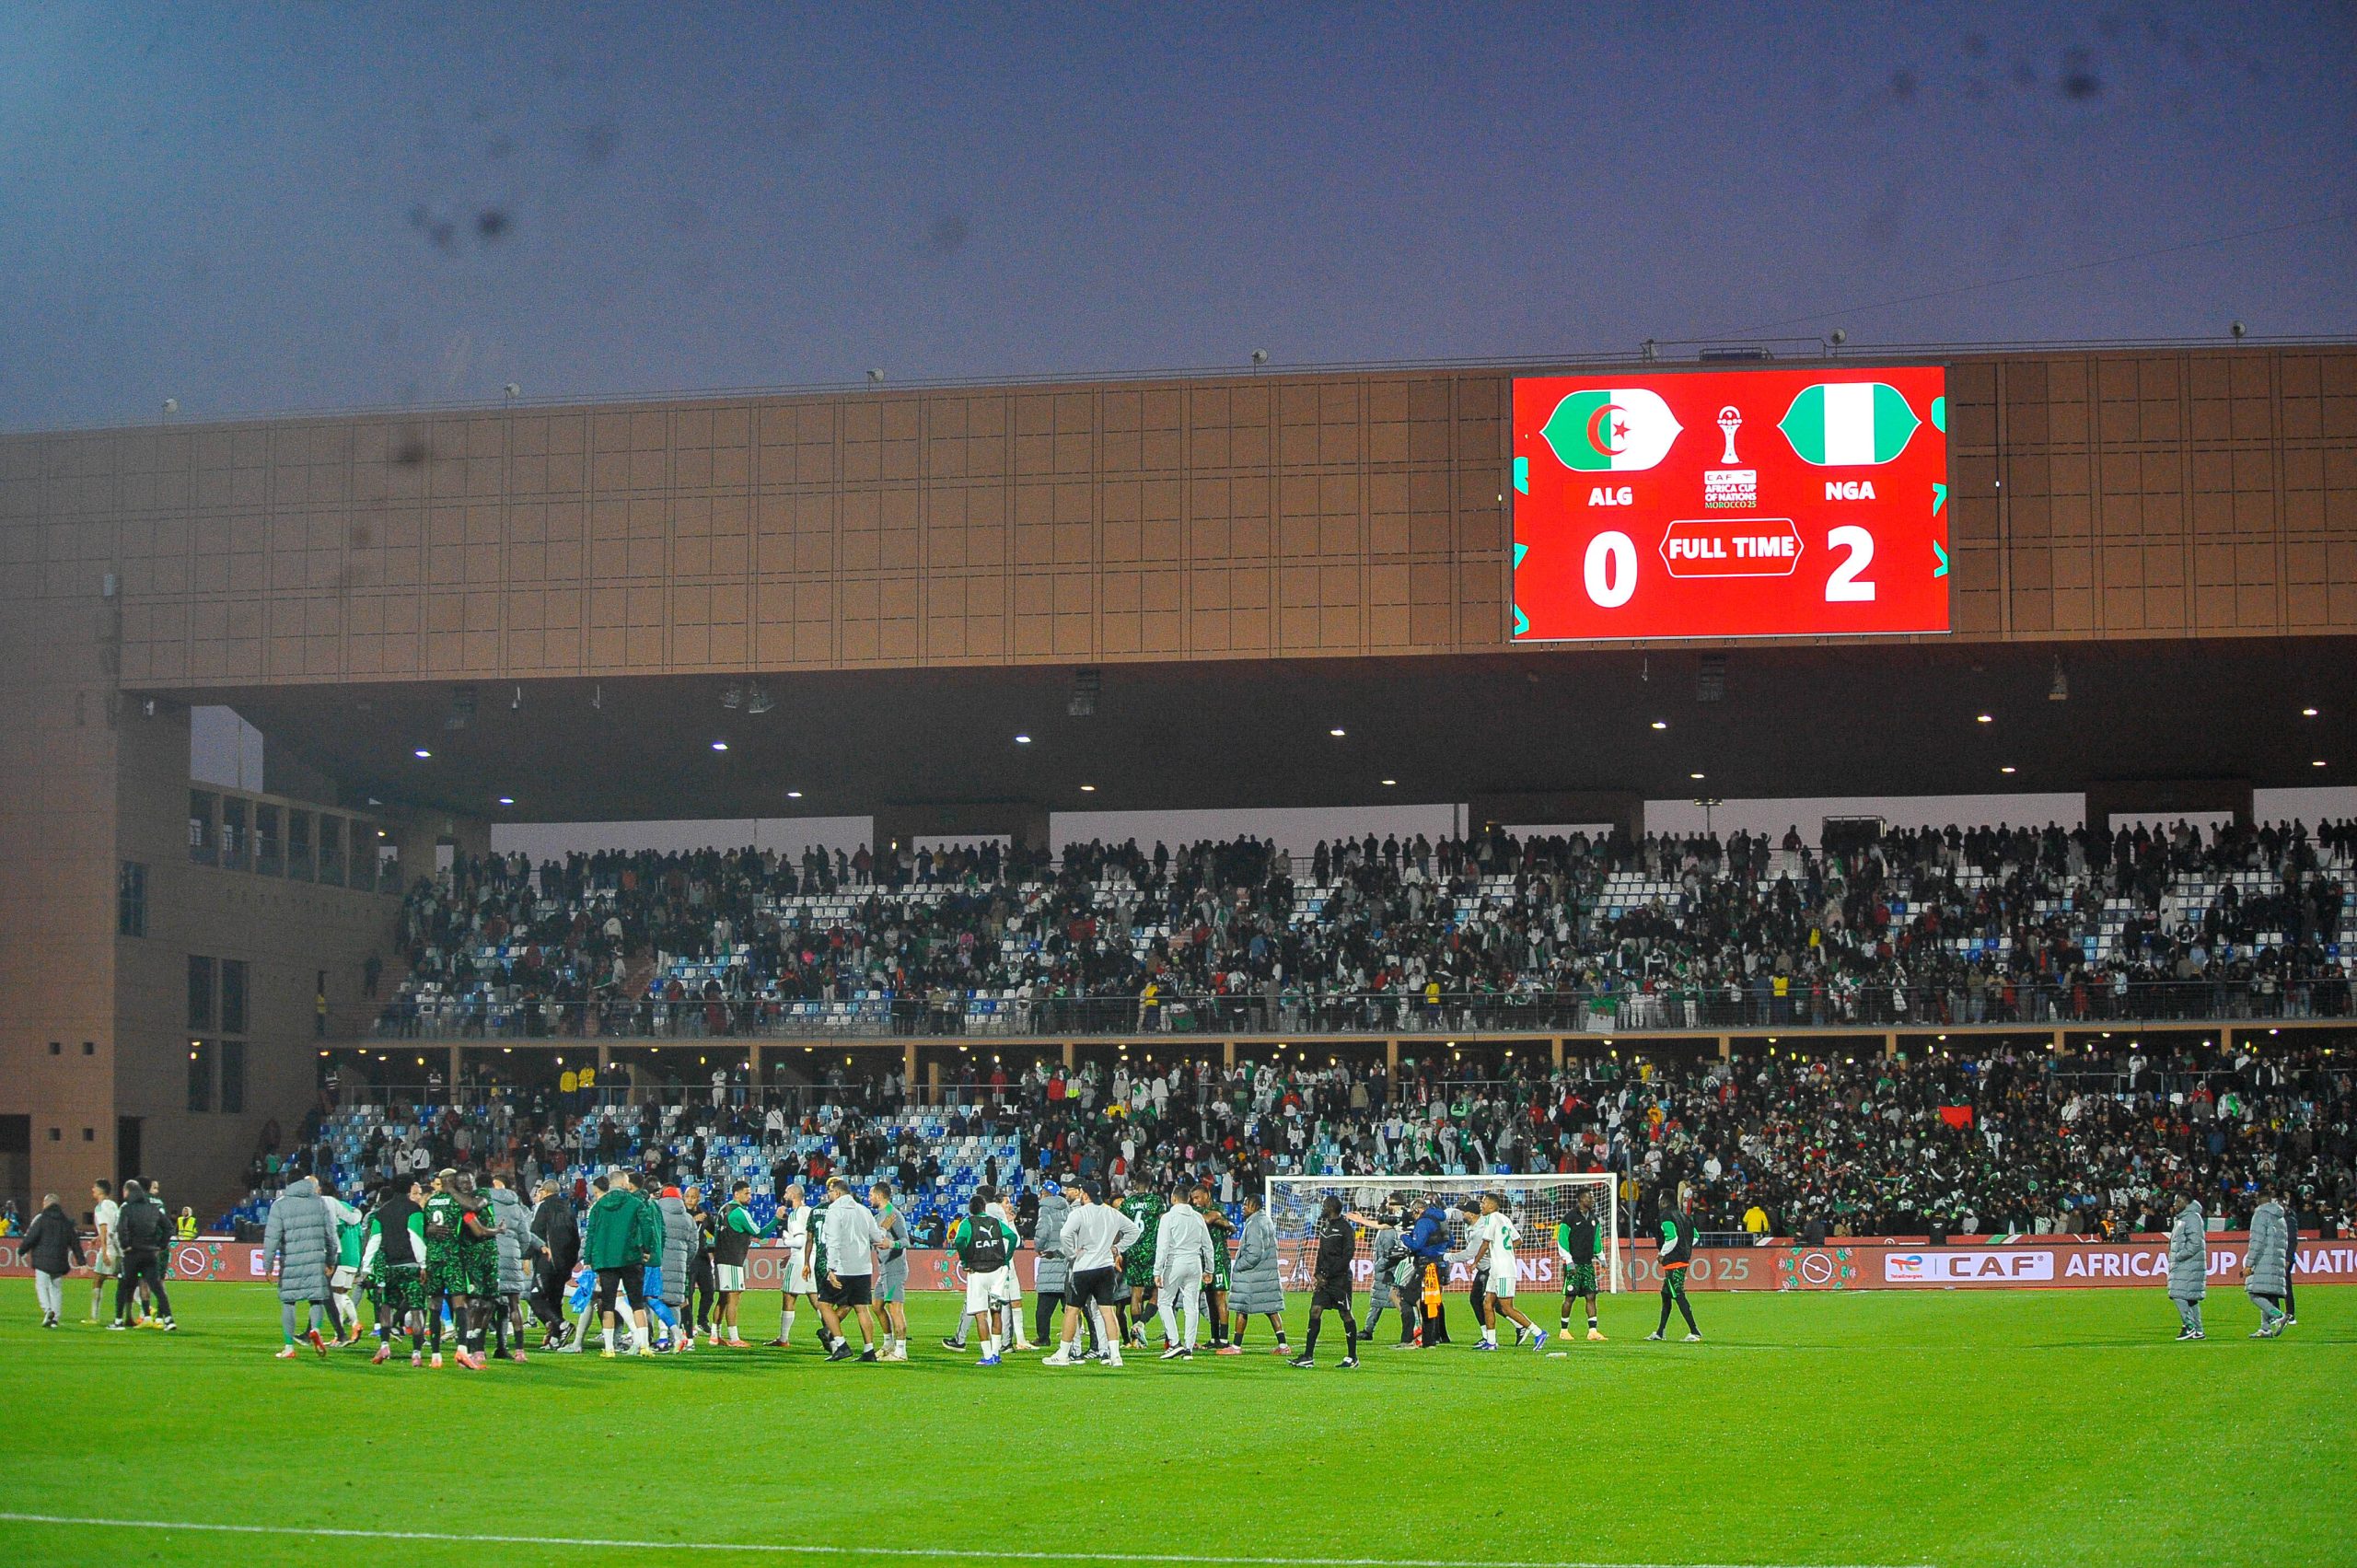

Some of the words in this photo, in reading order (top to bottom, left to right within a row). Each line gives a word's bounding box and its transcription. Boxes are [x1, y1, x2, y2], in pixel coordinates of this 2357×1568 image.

[1588, 487, 1632, 505] ALG
[1705, 484, 1738, 494] AFRICA
[1738, 483, 1757, 493] CUP
[1705, 494, 1718, 502] OF
[1718, 493, 1757, 502] NATIONS
[1826, 481, 1875, 500] NGA
[1669, 538, 1726, 559] FULL
[1732, 536, 1794, 557] TIME
[1584, 530, 1638, 608] 0
[1826, 525, 1875, 601] 2
[815, 1220, 827, 1245] 1
[1133, 1211, 1145, 1234] 6
[976, 1239, 998, 1249] CAF
[1718, 1258, 1749, 1281] 25
[1948, 1256, 2034, 1277] CAF
[2064, 1252, 2169, 1277] AFRICA
[2290, 1249, 2357, 1273] NATI
